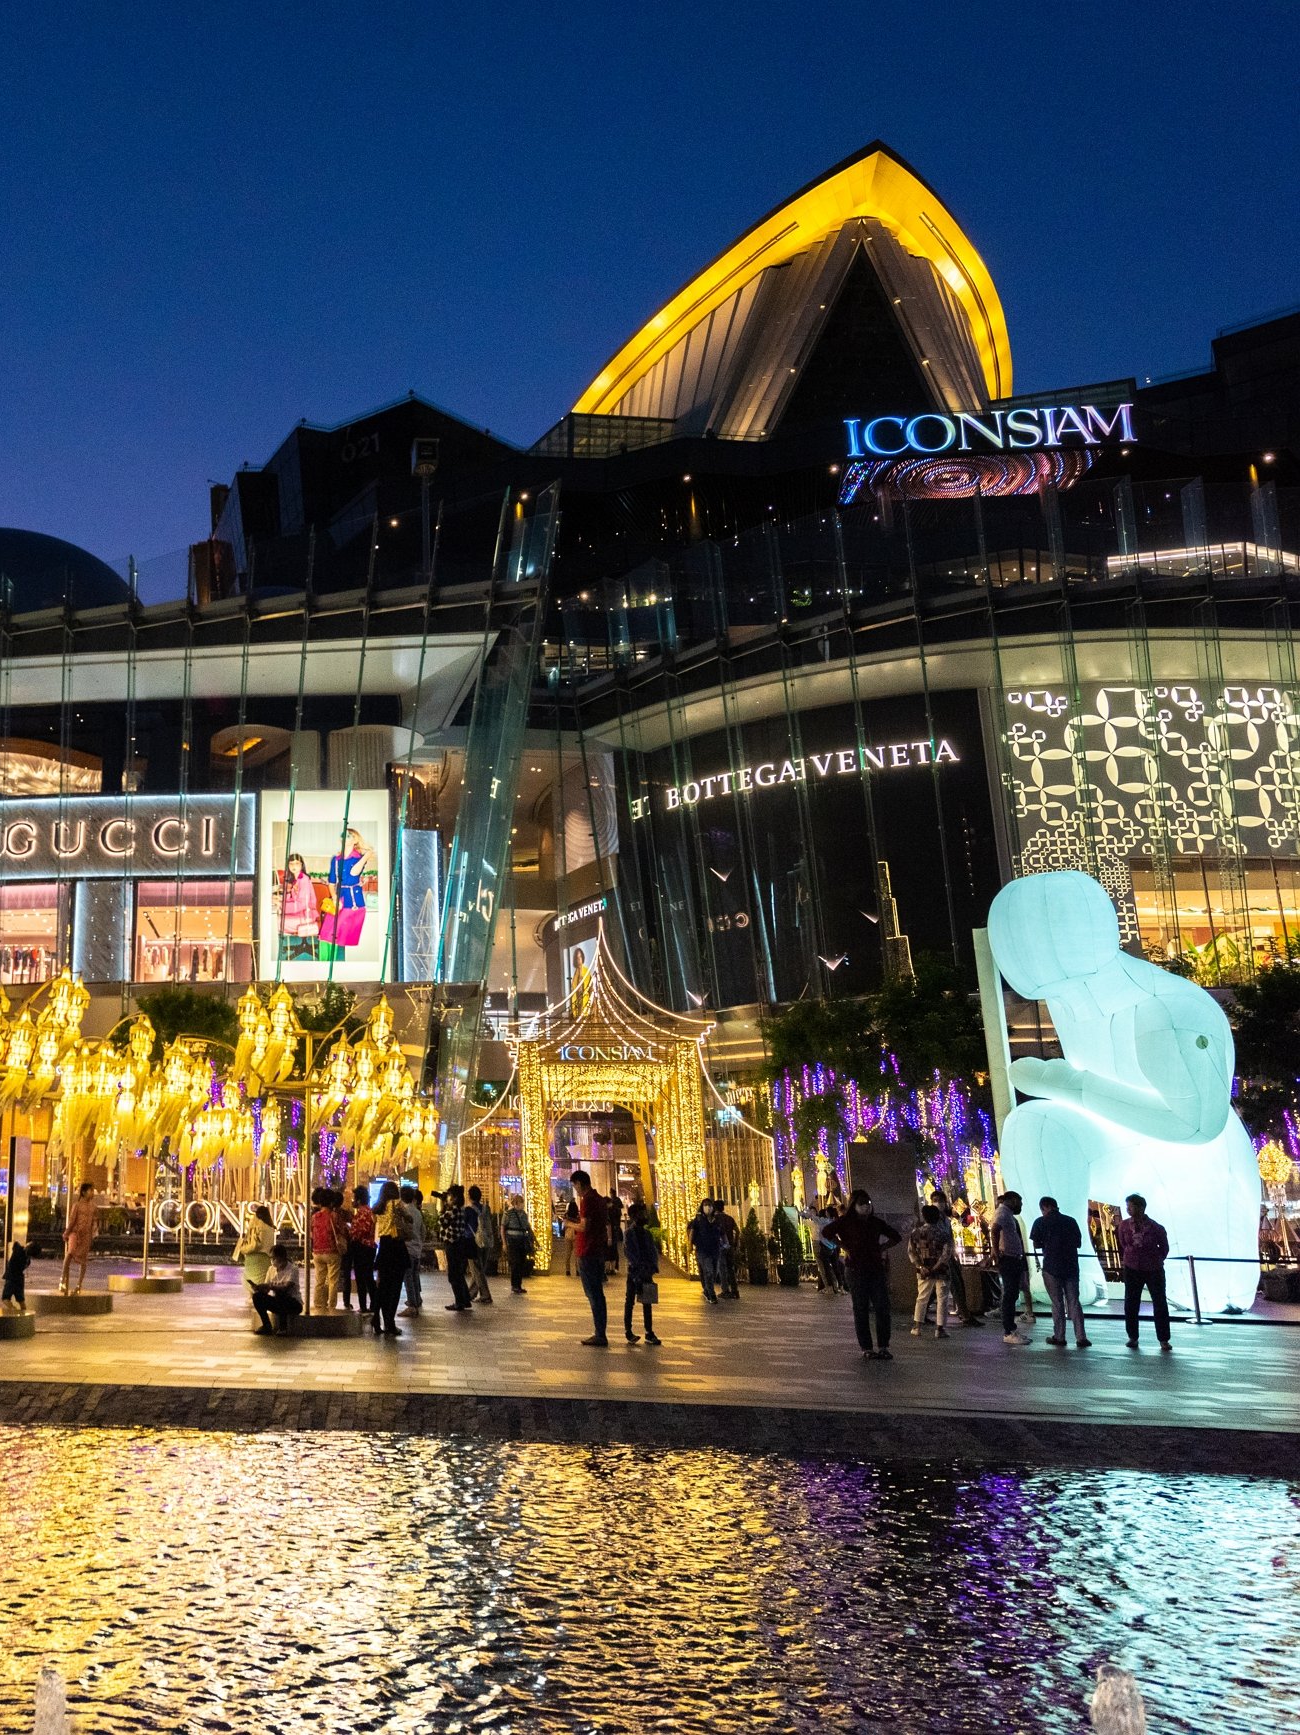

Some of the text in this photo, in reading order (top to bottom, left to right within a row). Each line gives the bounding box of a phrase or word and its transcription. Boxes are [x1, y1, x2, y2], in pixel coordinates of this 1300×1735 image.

[843, 403, 1138, 457] ICONSIAM
[666, 760, 798, 811] BOTTEGA
[810, 739, 960, 776] VENETA
[3, 816, 215, 858] GUCCI
[560, 1045, 654, 1061] ICONSIAM
